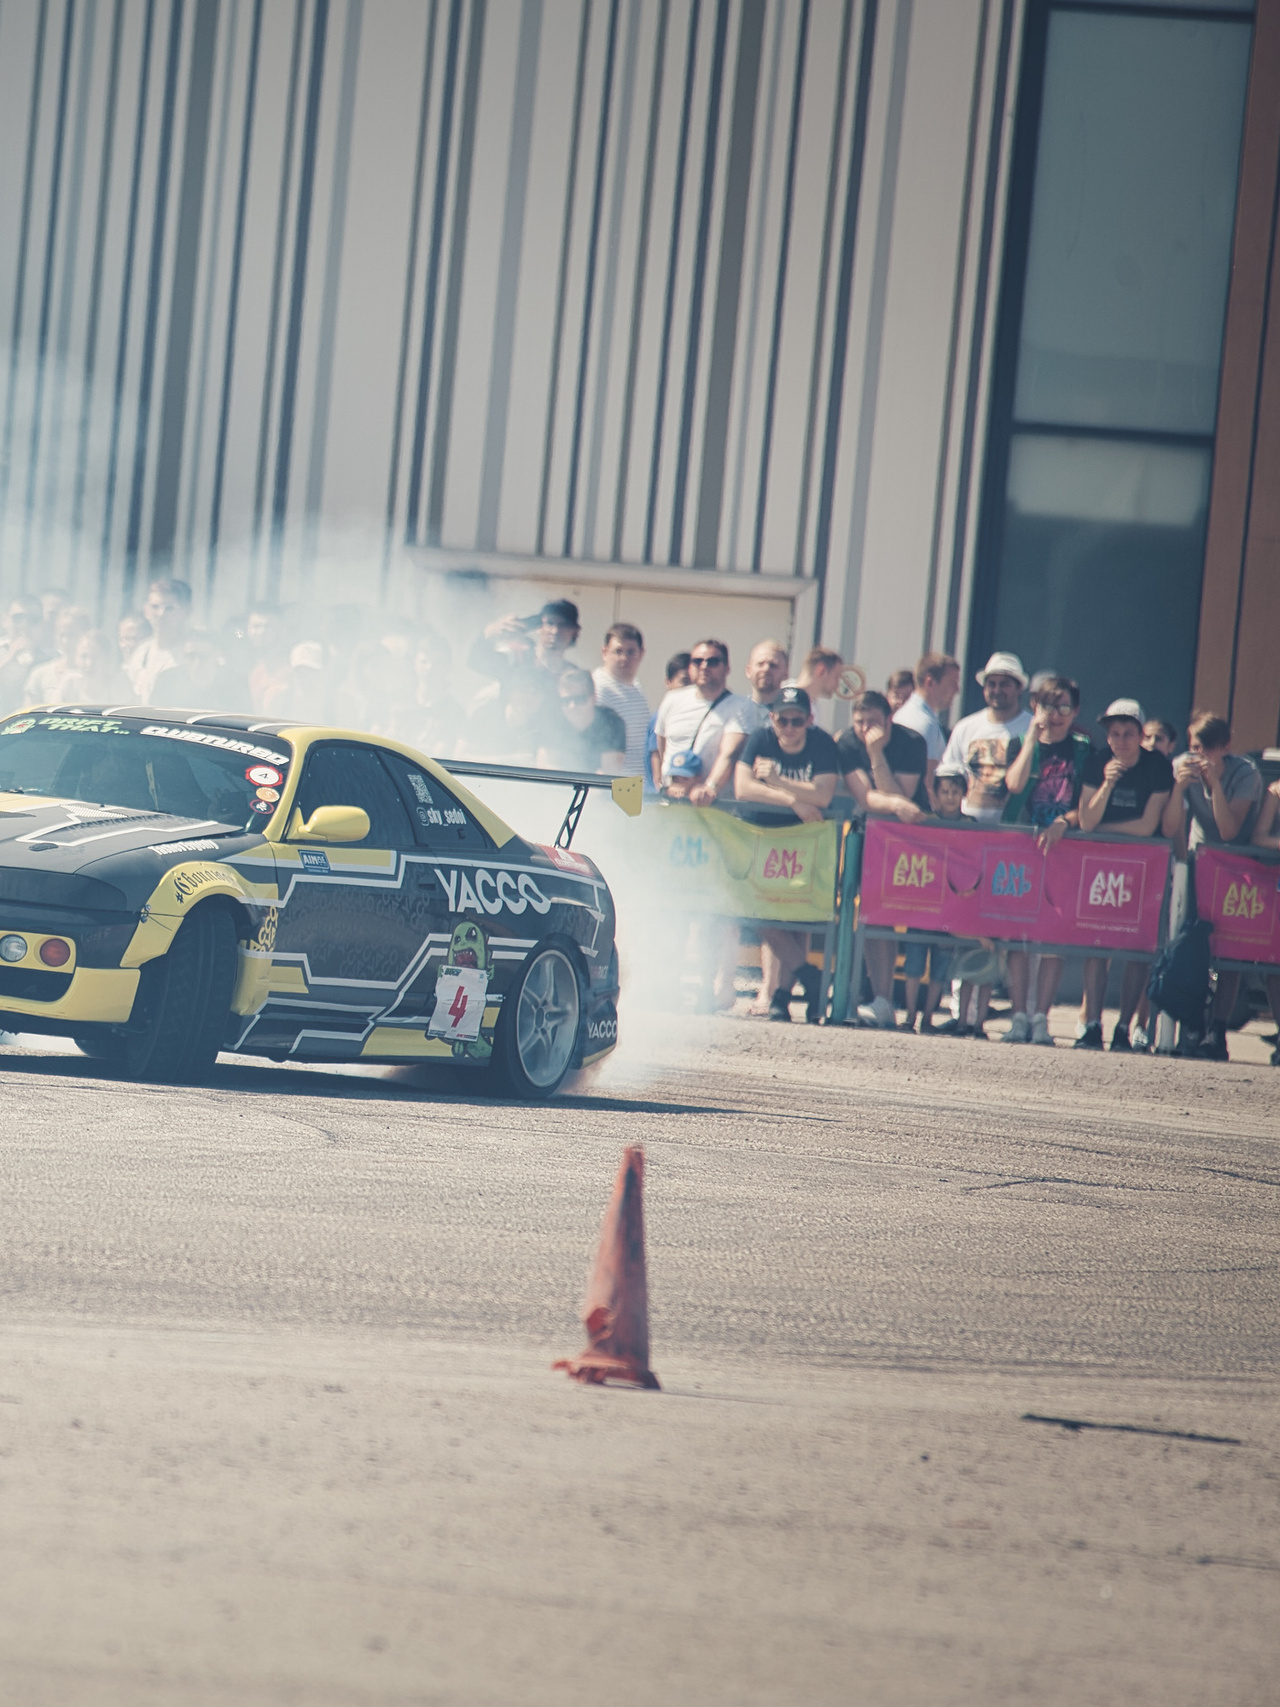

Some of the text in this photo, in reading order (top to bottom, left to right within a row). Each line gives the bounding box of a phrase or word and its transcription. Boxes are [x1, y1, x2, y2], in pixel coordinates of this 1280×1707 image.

[434, 869, 551, 914] YACCO
[1092, 870, 1124, 889] АМ
[448, 985, 468, 1028] 4
